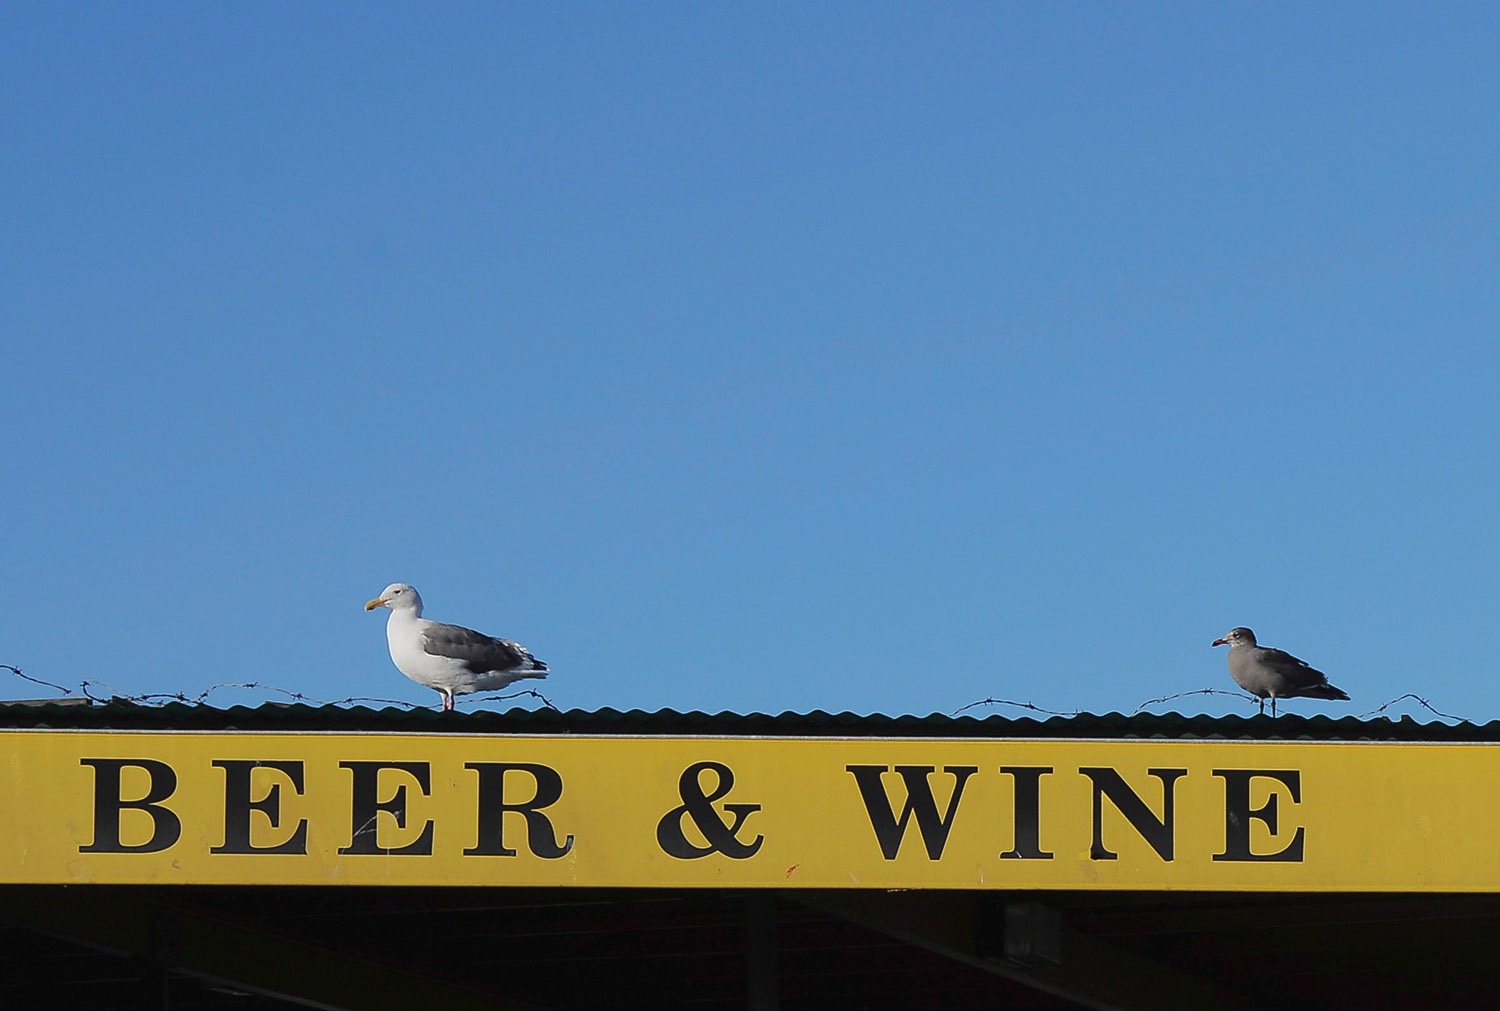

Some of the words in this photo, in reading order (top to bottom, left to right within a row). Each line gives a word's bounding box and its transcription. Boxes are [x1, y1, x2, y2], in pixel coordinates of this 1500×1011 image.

[78, 758, 576, 859] BEER
[656, 761, 765, 860] &
[845, 764, 1306, 863] WINE
